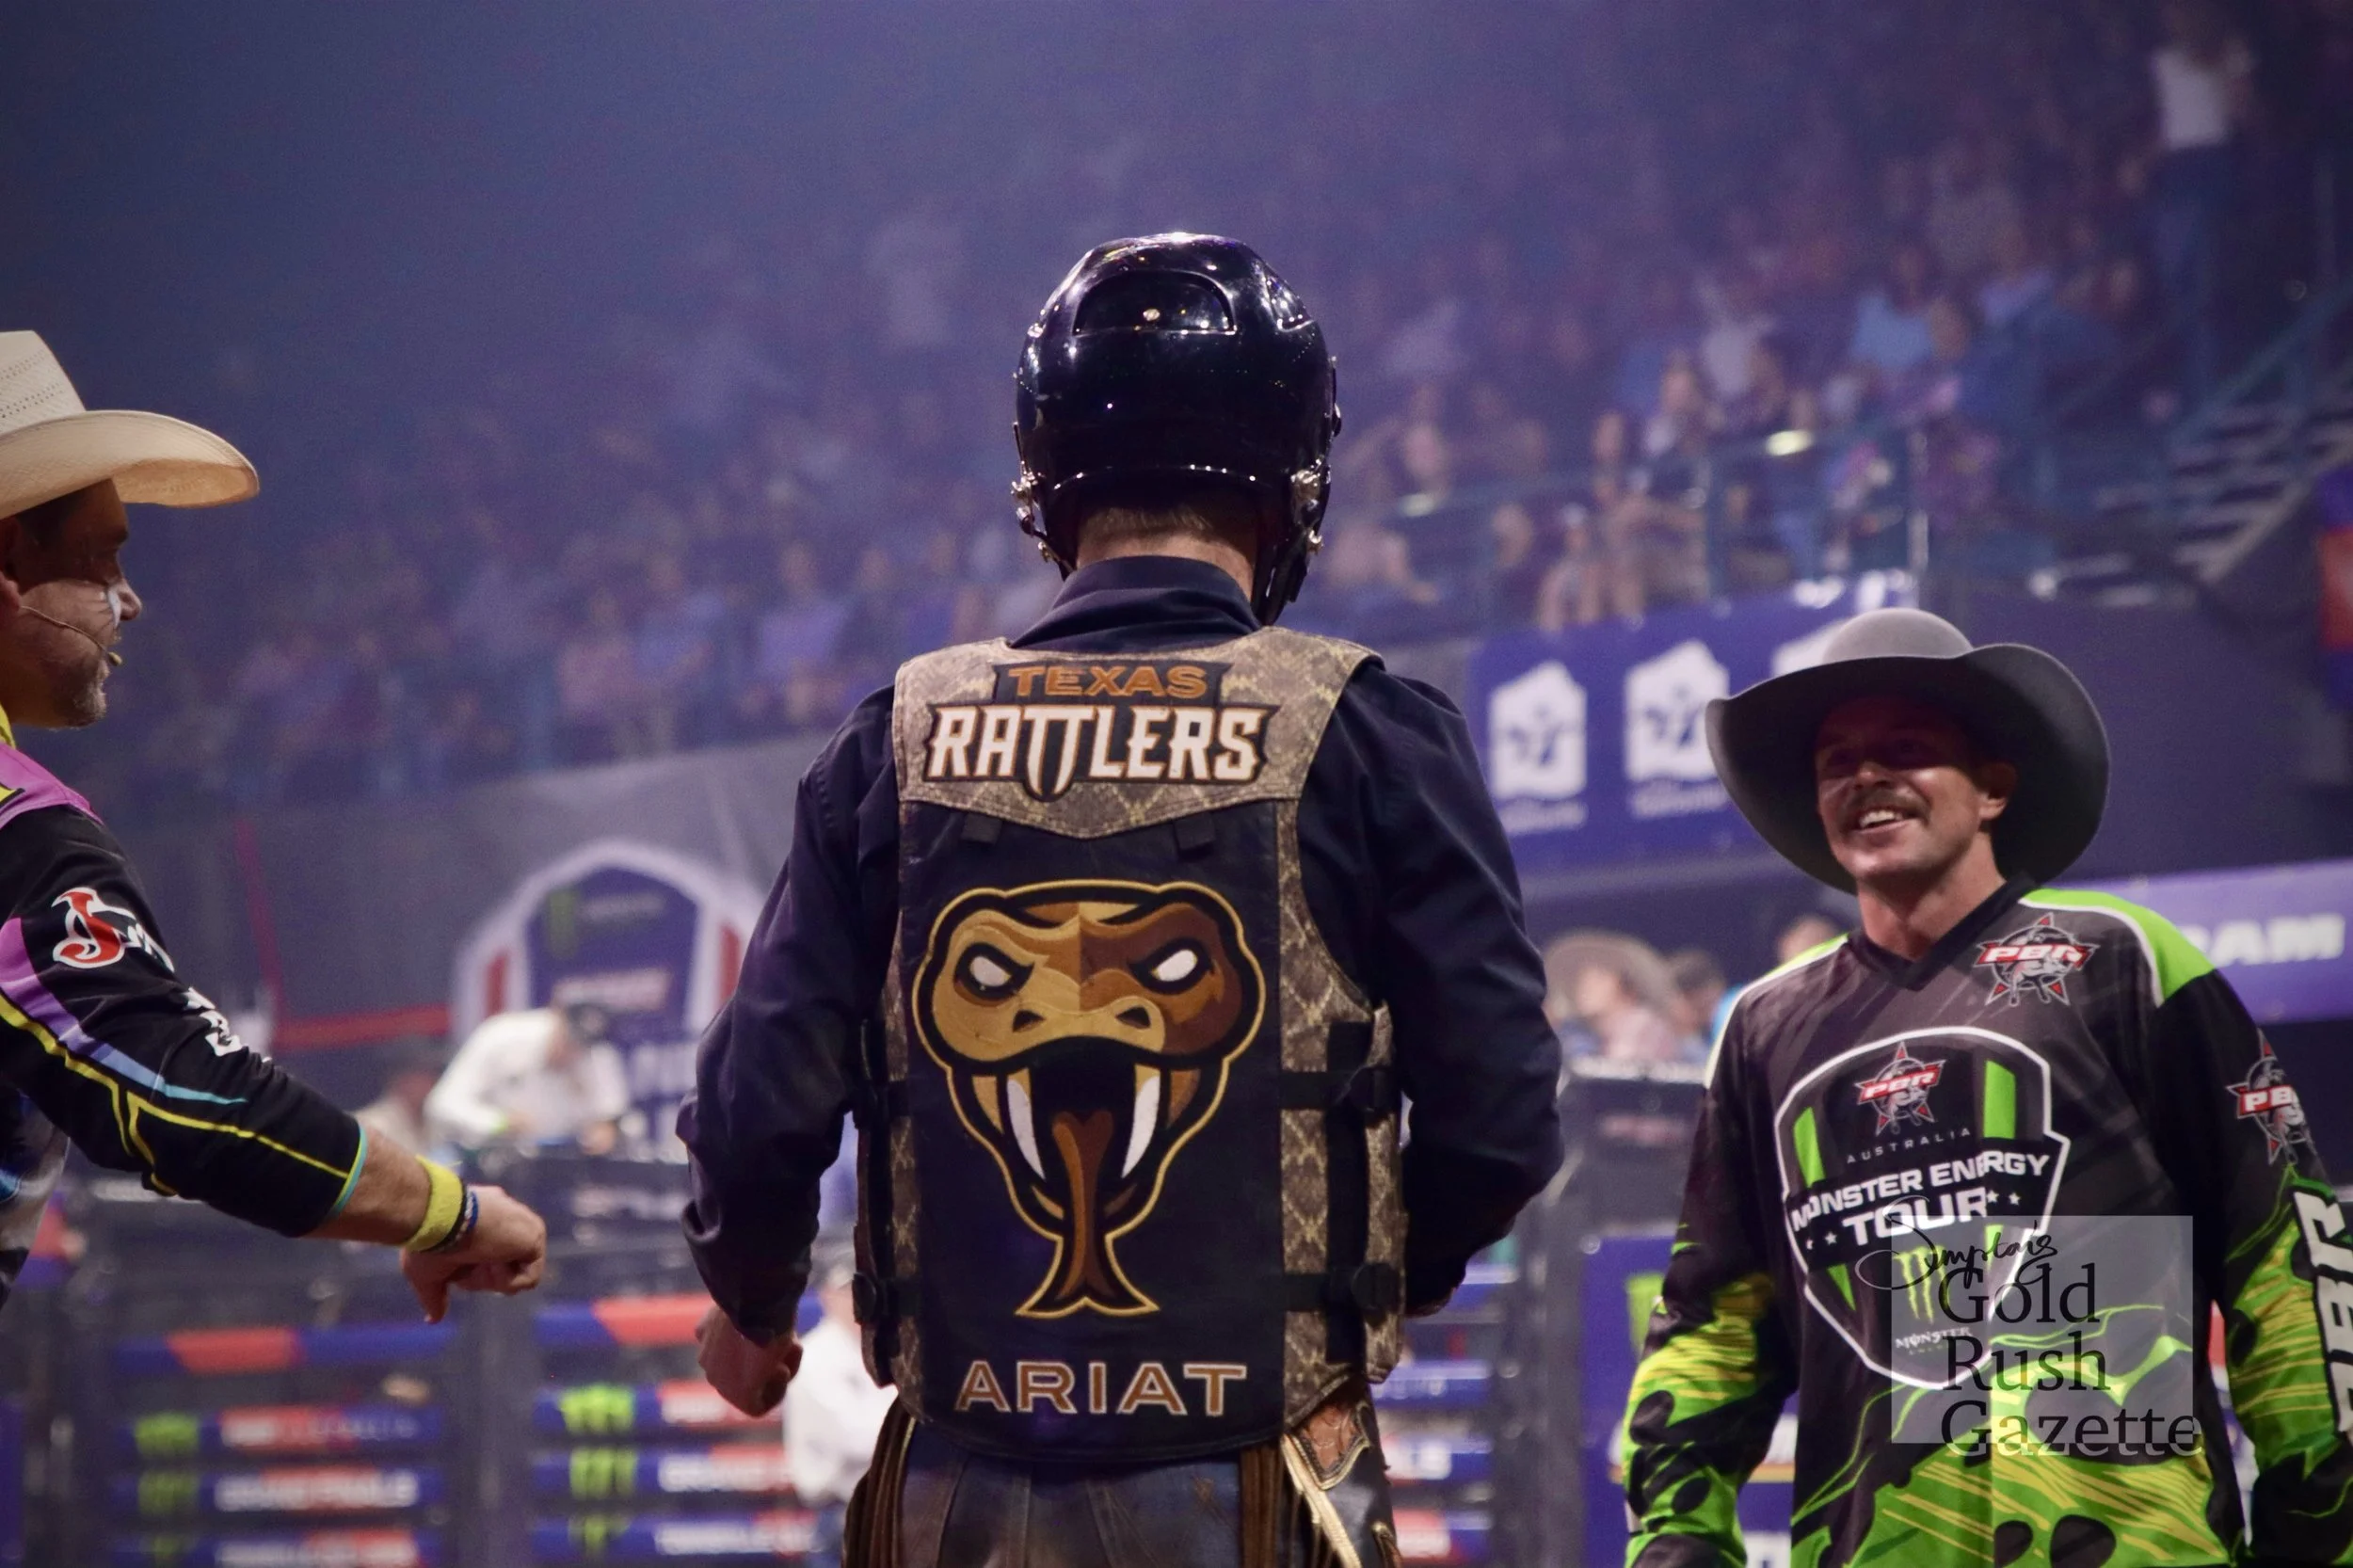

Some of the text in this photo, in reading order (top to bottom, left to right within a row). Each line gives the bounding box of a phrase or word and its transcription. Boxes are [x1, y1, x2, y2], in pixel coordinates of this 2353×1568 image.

[1008, 664, 1209, 699] TEXAS
[925, 704, 1270, 796] RATTLERS
[1983, 944, 2084, 963] PBR
[1864, 1070, 1936, 1099] PBR
[2244, 1086, 2302, 1112] PB
[1847, 1128, 1971, 1164] AUSTRALIA
[1842, 1186, 1988, 1246] TOUR
[1895, 1326, 1974, 1349] MONSTER
[954, 1360, 1247, 1416] ARIAT
